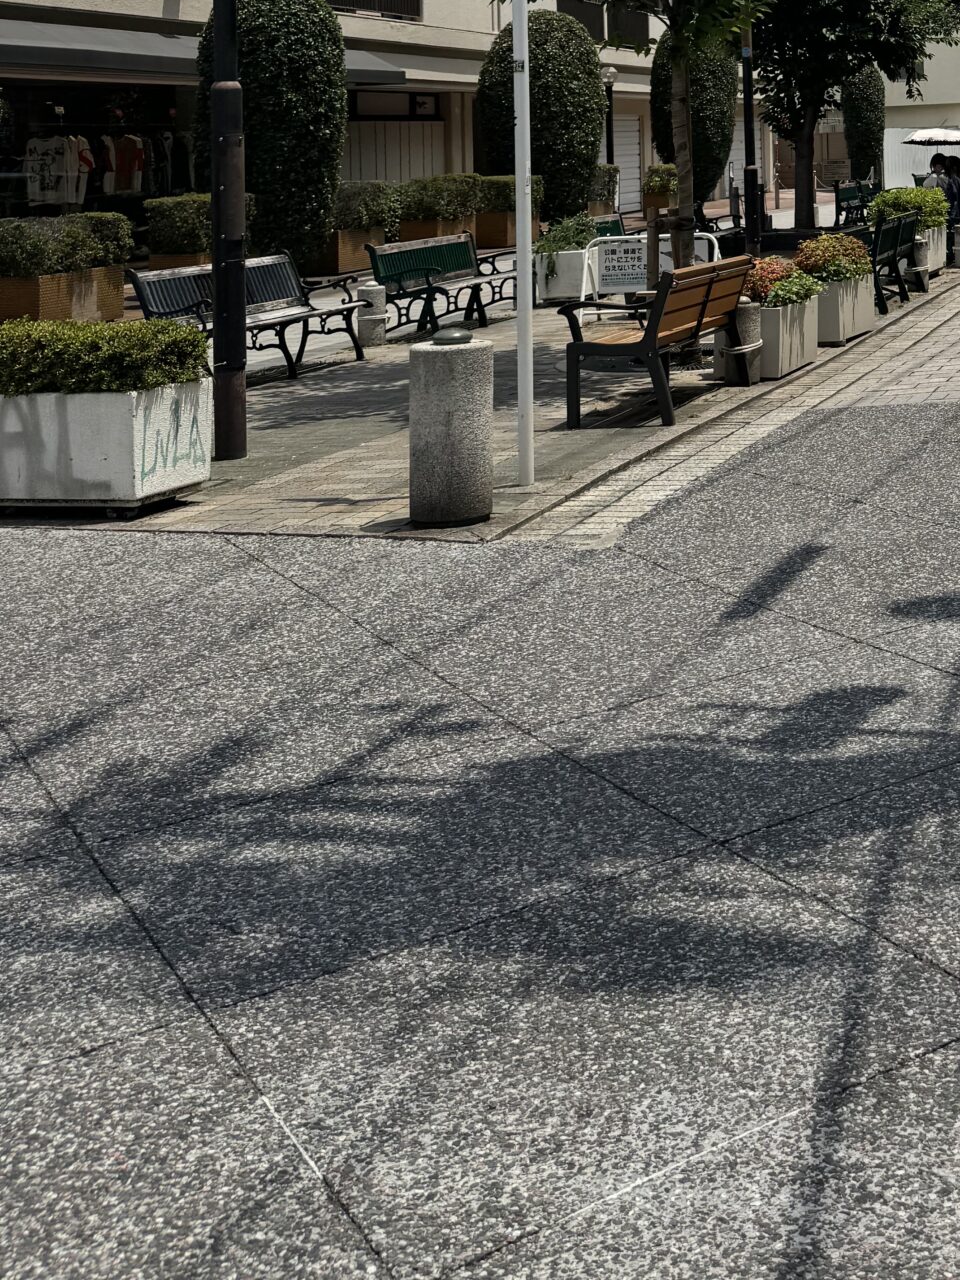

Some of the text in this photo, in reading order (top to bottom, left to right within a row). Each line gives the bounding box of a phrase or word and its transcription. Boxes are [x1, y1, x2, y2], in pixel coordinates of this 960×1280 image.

[604, 256, 643, 264] ハトにエサを
